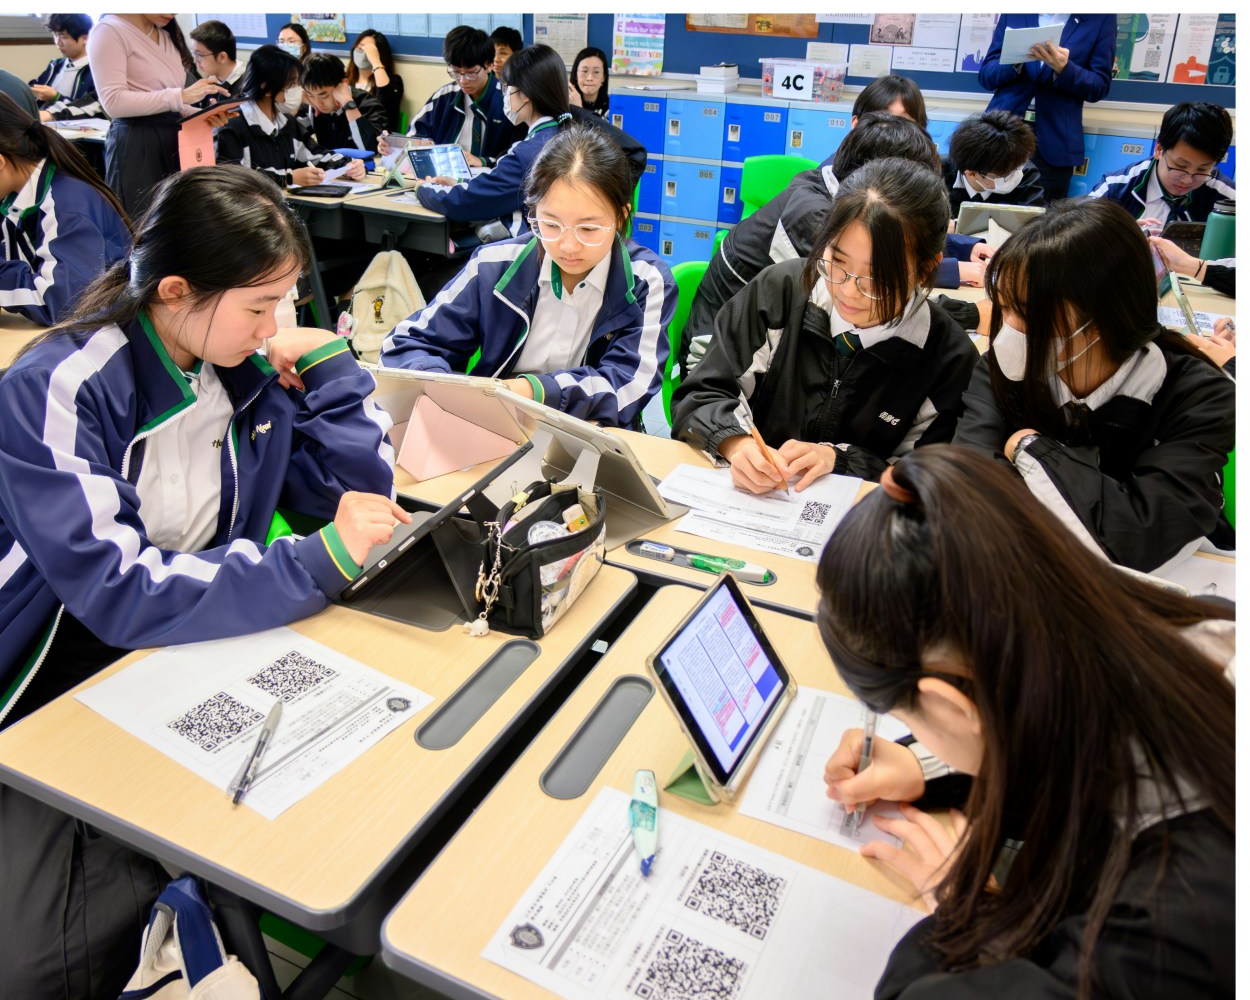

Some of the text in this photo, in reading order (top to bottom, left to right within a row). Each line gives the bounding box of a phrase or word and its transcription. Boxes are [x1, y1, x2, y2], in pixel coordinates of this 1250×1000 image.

[782, 74, 805, 91] 4C
[703, 108, 718, 116] 004
[765, 113, 779, 121] 007
[830, 119, 845, 127] 010
[1123, 145, 1142, 154] 022
